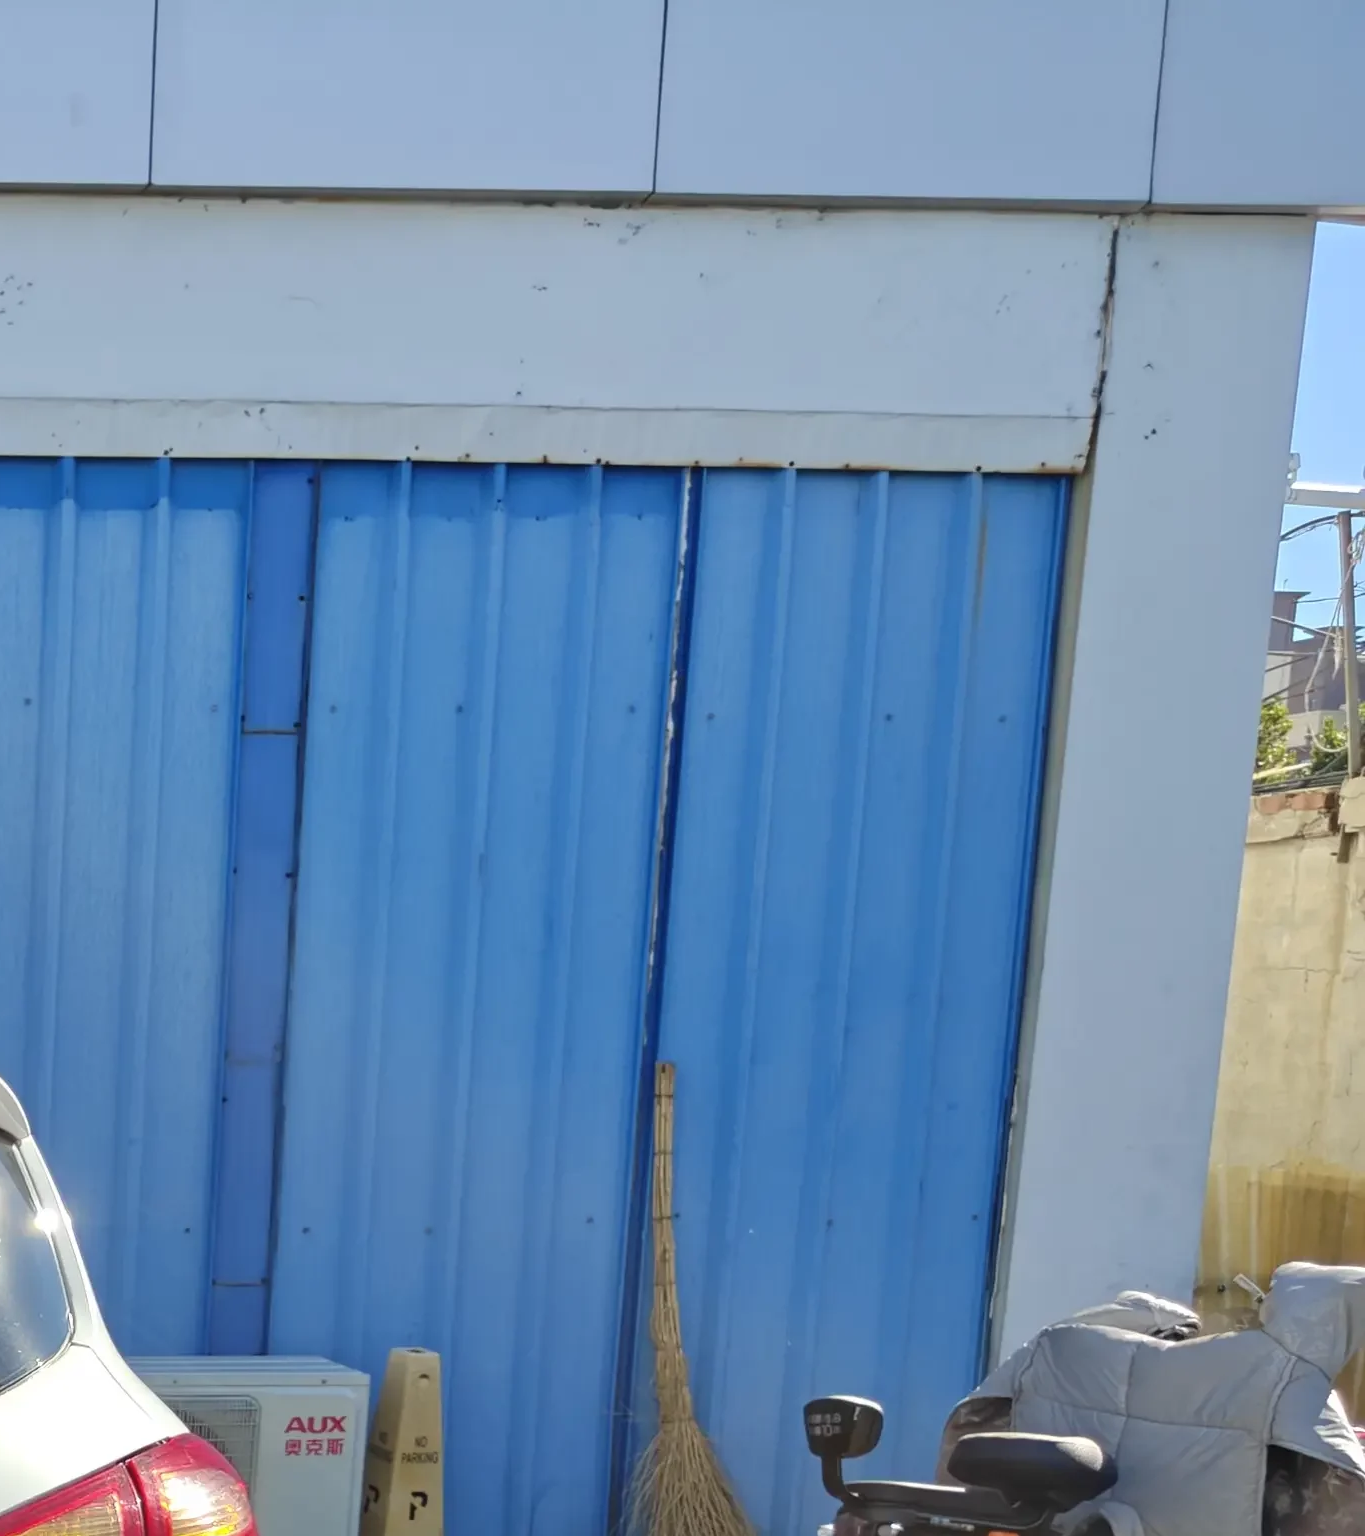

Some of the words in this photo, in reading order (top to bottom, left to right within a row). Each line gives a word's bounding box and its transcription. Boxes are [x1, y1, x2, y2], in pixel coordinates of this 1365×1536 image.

[284, 1416, 346, 1433] AUX
[285, 1438, 345, 1456] 奥克斯
[414, 1435, 428, 1448] NO
[401, 1450, 439, 1464] PARKING
